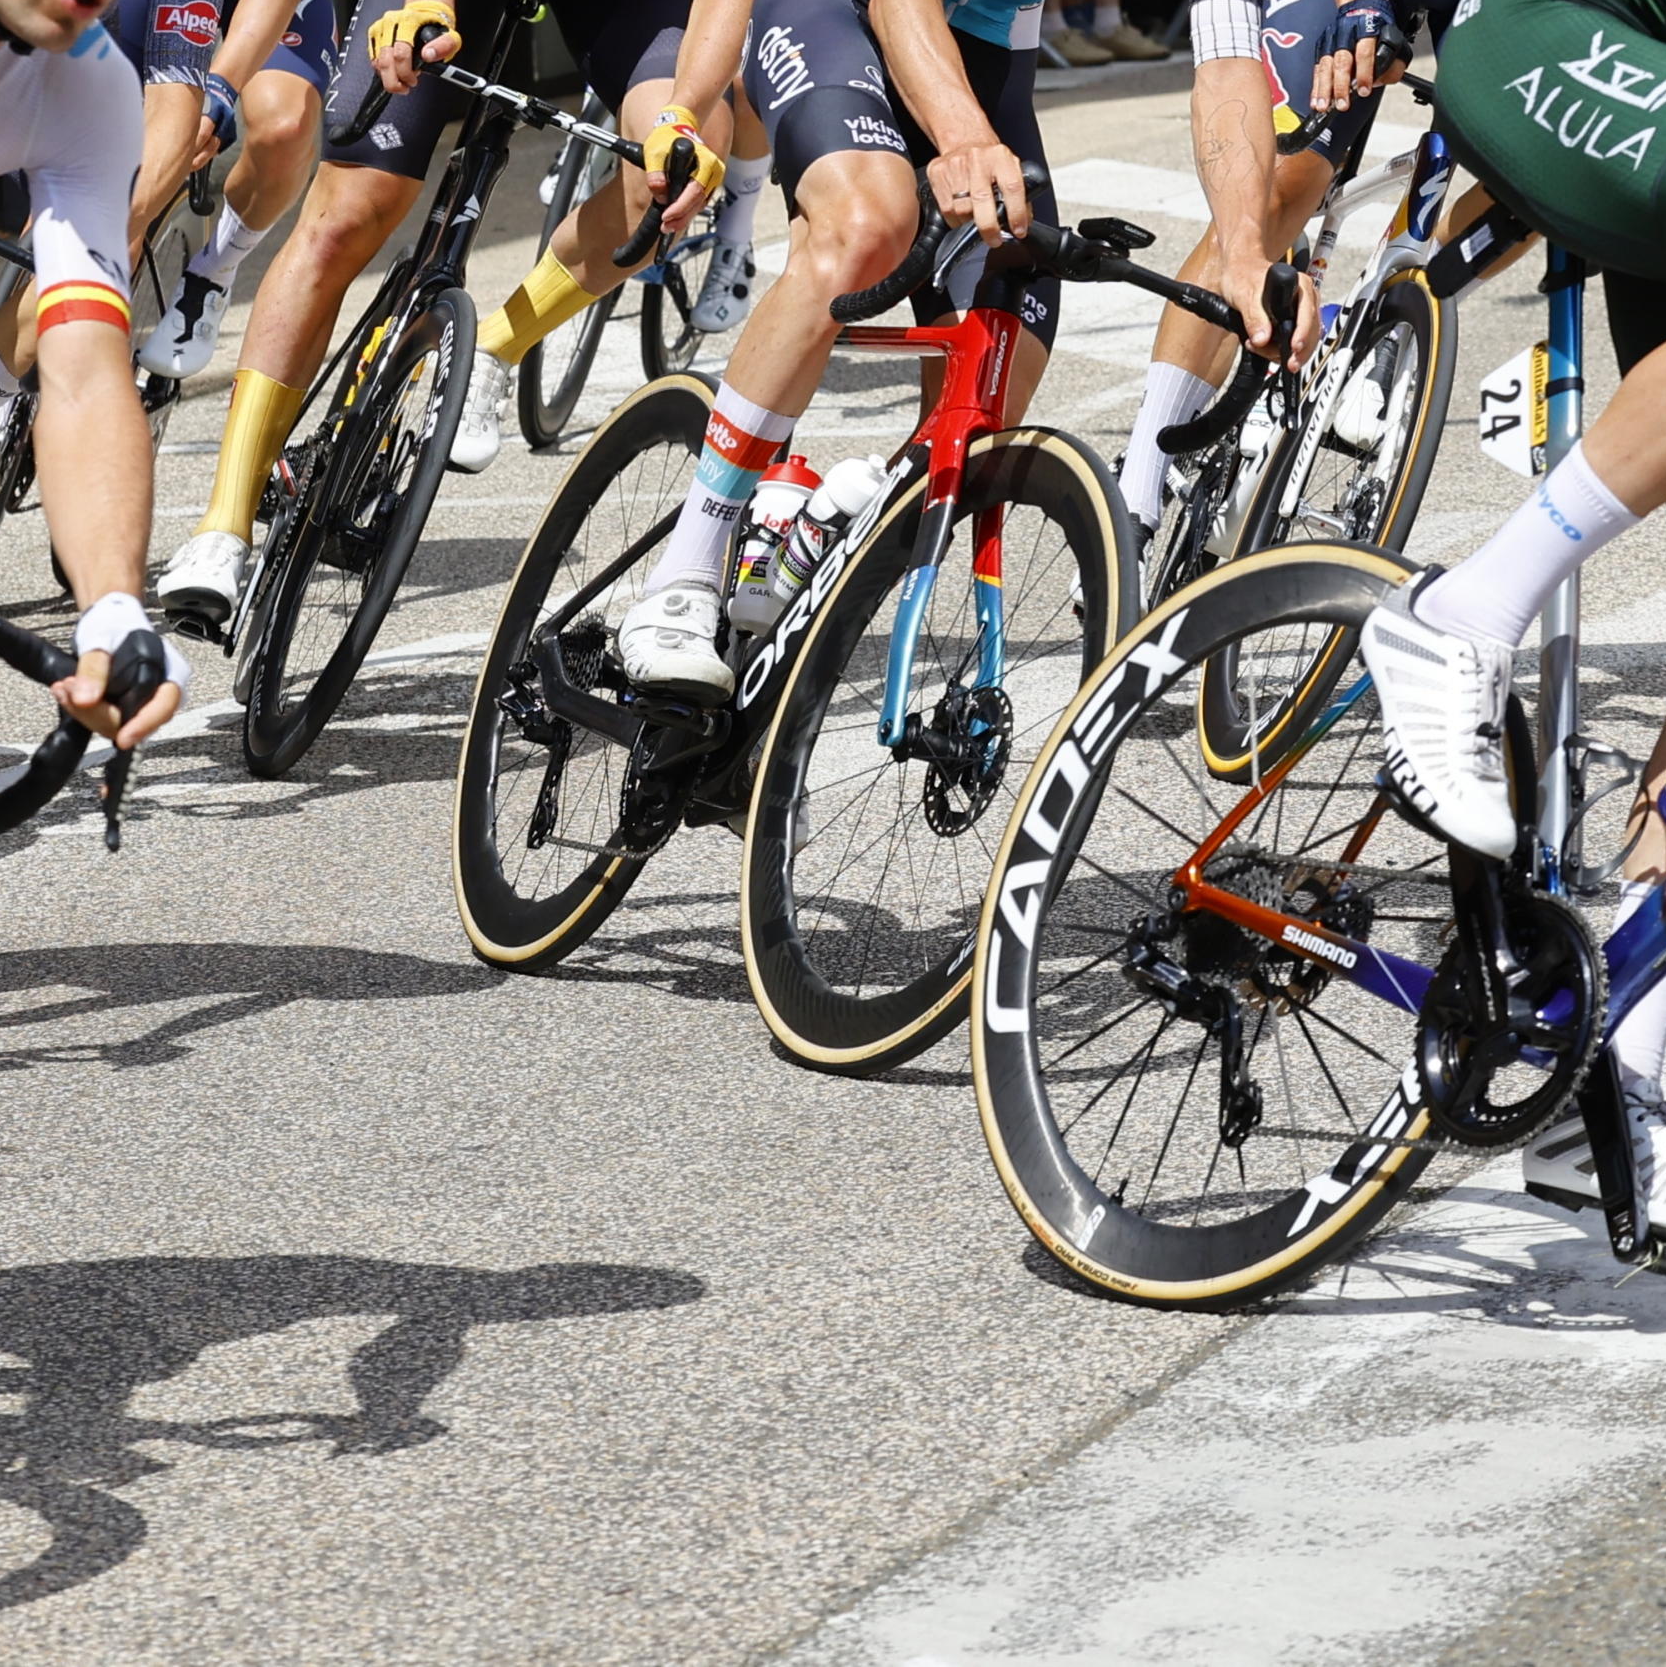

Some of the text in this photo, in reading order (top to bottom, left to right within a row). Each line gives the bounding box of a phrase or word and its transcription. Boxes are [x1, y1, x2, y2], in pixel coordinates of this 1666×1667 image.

[760, 25, 816, 111] dstny
[1502, 65, 1659, 172] ALULA
[988, 328, 1009, 399] ORBEA
[1481, 378, 1522, 443] 24
[737, 457, 915, 711] ORBEA
[985, 607, 1191, 1035] CADEX
[1282, 923, 1359, 971] SHIMANO
